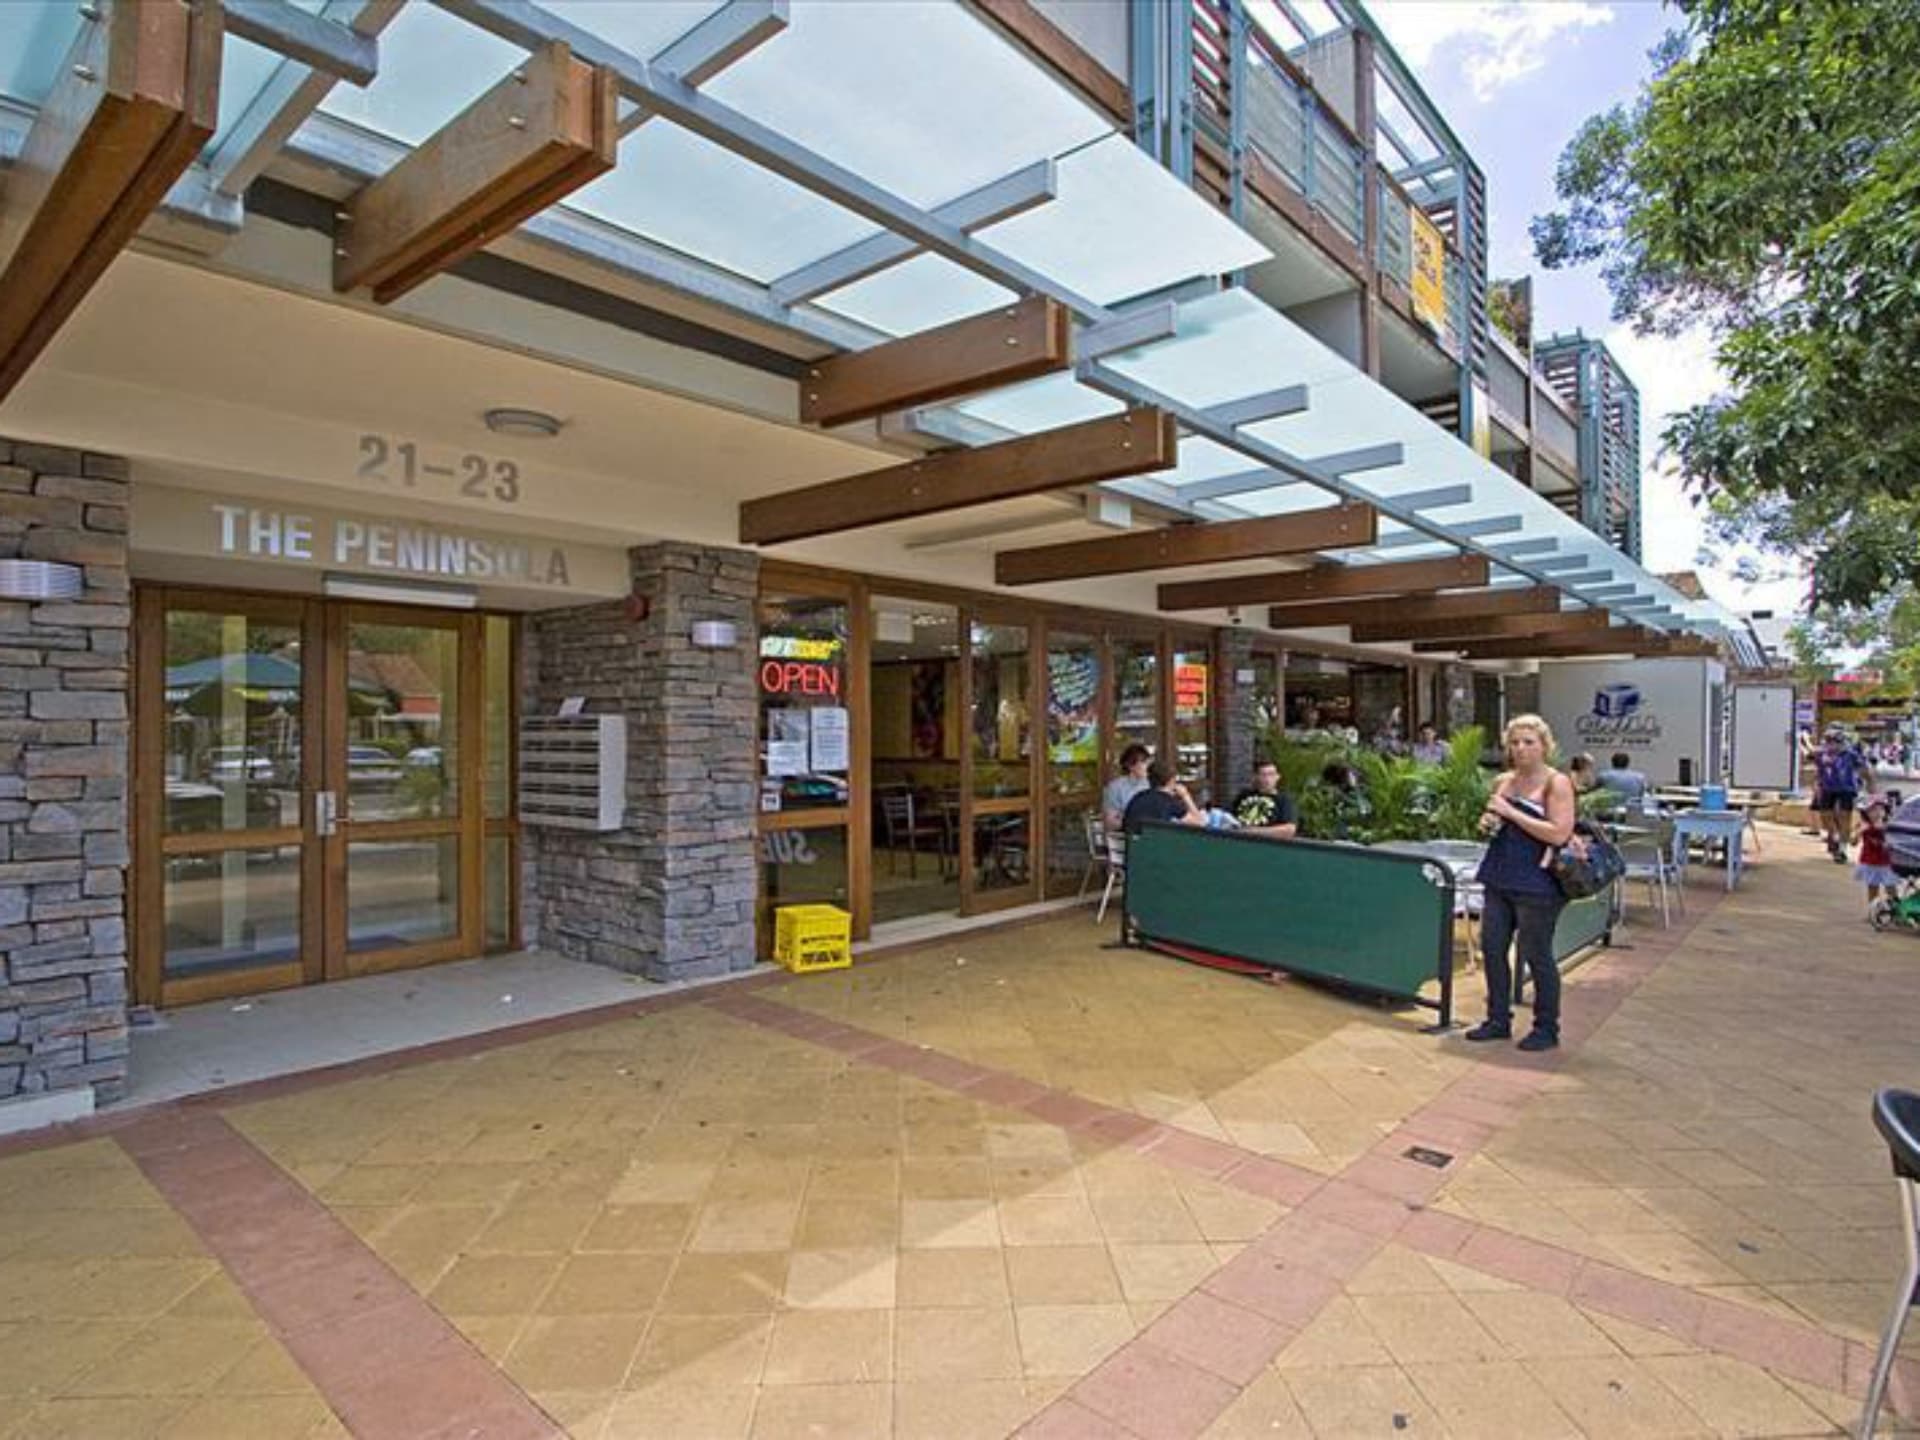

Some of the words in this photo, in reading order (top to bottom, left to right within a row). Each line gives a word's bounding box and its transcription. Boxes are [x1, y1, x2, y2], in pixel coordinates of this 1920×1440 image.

[356, 434, 520, 502] 21-23
[212, 504, 313, 560] THE
[761, 660, 839, 695] OPEN
